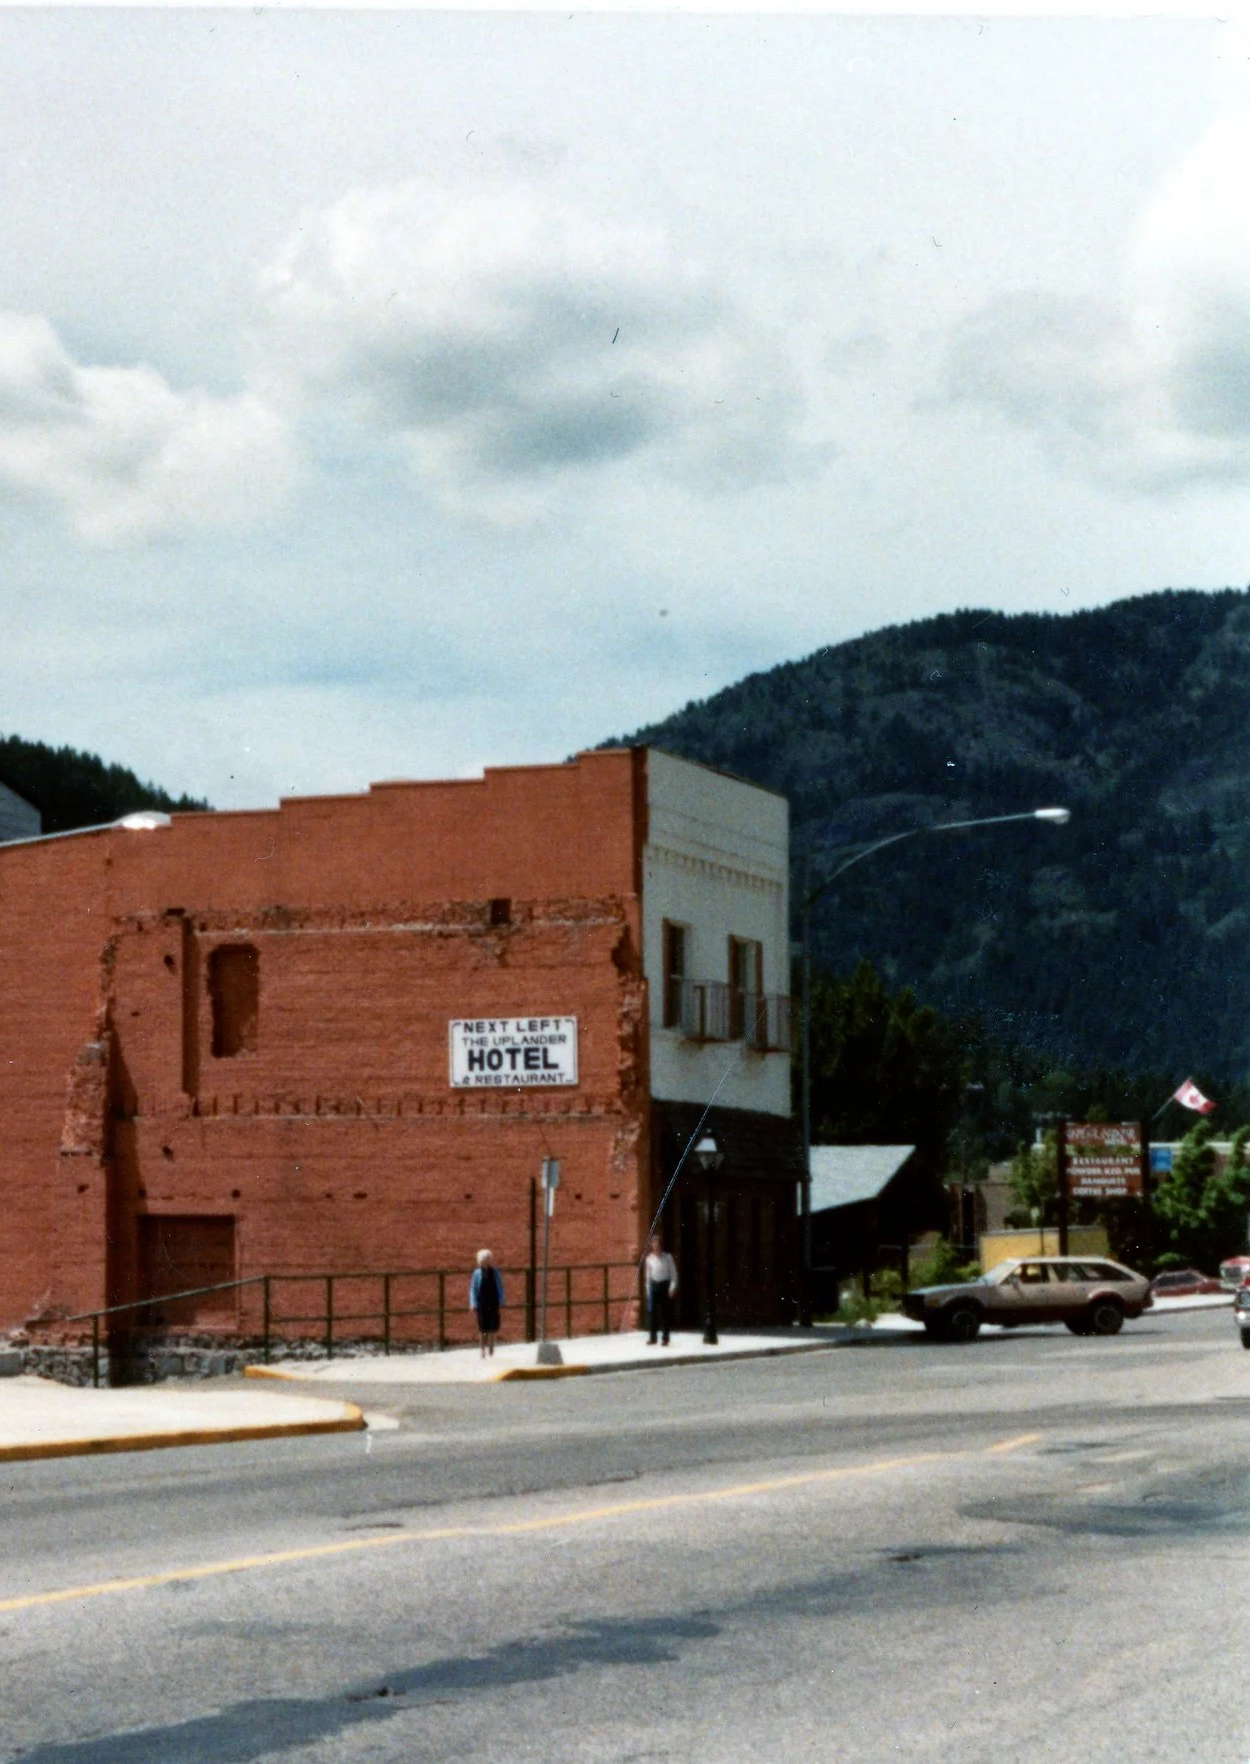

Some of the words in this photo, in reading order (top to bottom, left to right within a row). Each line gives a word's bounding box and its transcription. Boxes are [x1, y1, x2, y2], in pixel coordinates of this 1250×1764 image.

[463, 1021, 509, 1033] NEXT
[516, 1019, 562, 1032] LEFT
[462, 1036, 489, 1046] THE
[492, 1034, 567, 1046] UPLANDER
[467, 1047, 559, 1071] HOTEL
[462, 1076, 470, 1085] &
[475, 1073, 564, 1085] RESTAURANT
[1072, 1157, 1134, 1165] RESTAURANT
[1105, 1187, 1128, 1196] SHOP
